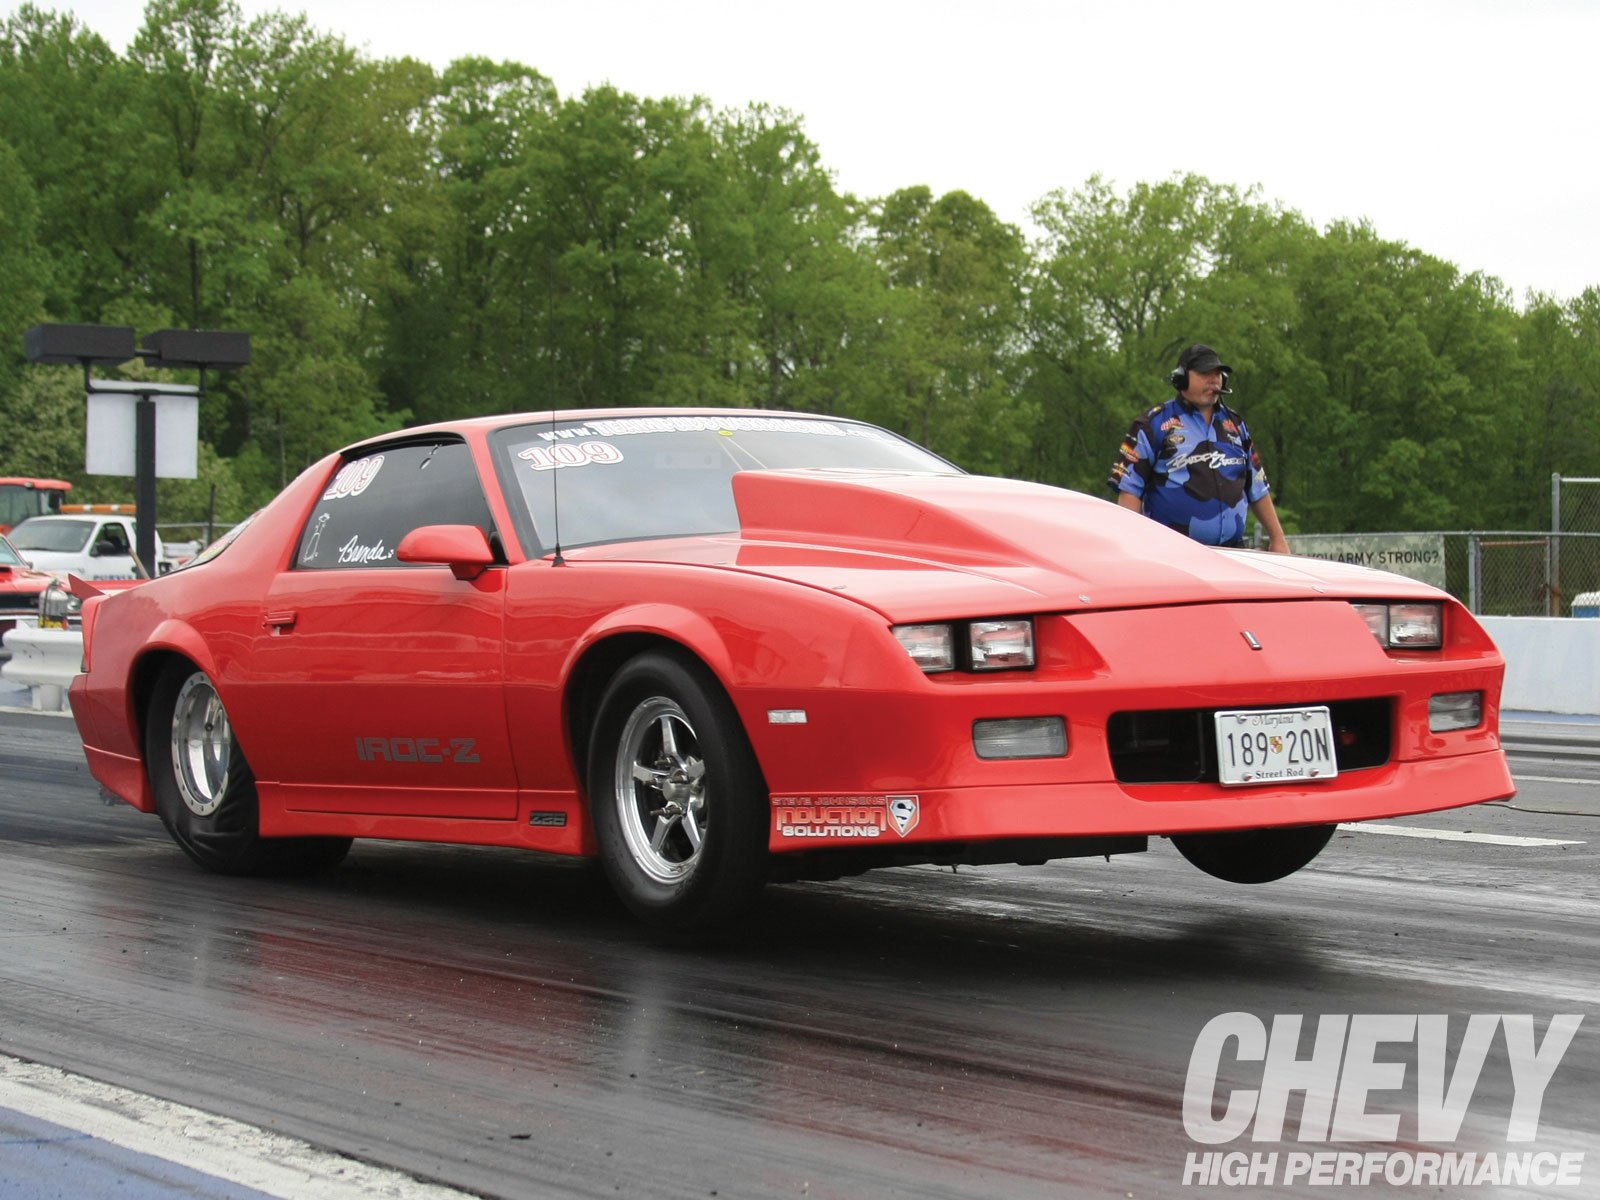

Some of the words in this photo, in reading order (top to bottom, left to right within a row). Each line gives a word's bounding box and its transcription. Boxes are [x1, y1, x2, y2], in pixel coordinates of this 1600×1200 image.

[518, 441, 624, 471] 109
[323, 455, 385, 500] 109
[1337, 551, 1375, 564] ARMY
[1378, 551, 1440, 564] STRONG?
[1251, 714, 1294, 728] Maryland
[355, 736, 481, 764] IROC-Z
[1227, 732, 1268, 766] 189
[1255, 770, 1283, 779] Street
[1286, 768, 1304, 777] Rod
[771, 796, 812, 806] STEVE
[782, 825, 881, 837] SOLUTIONS
